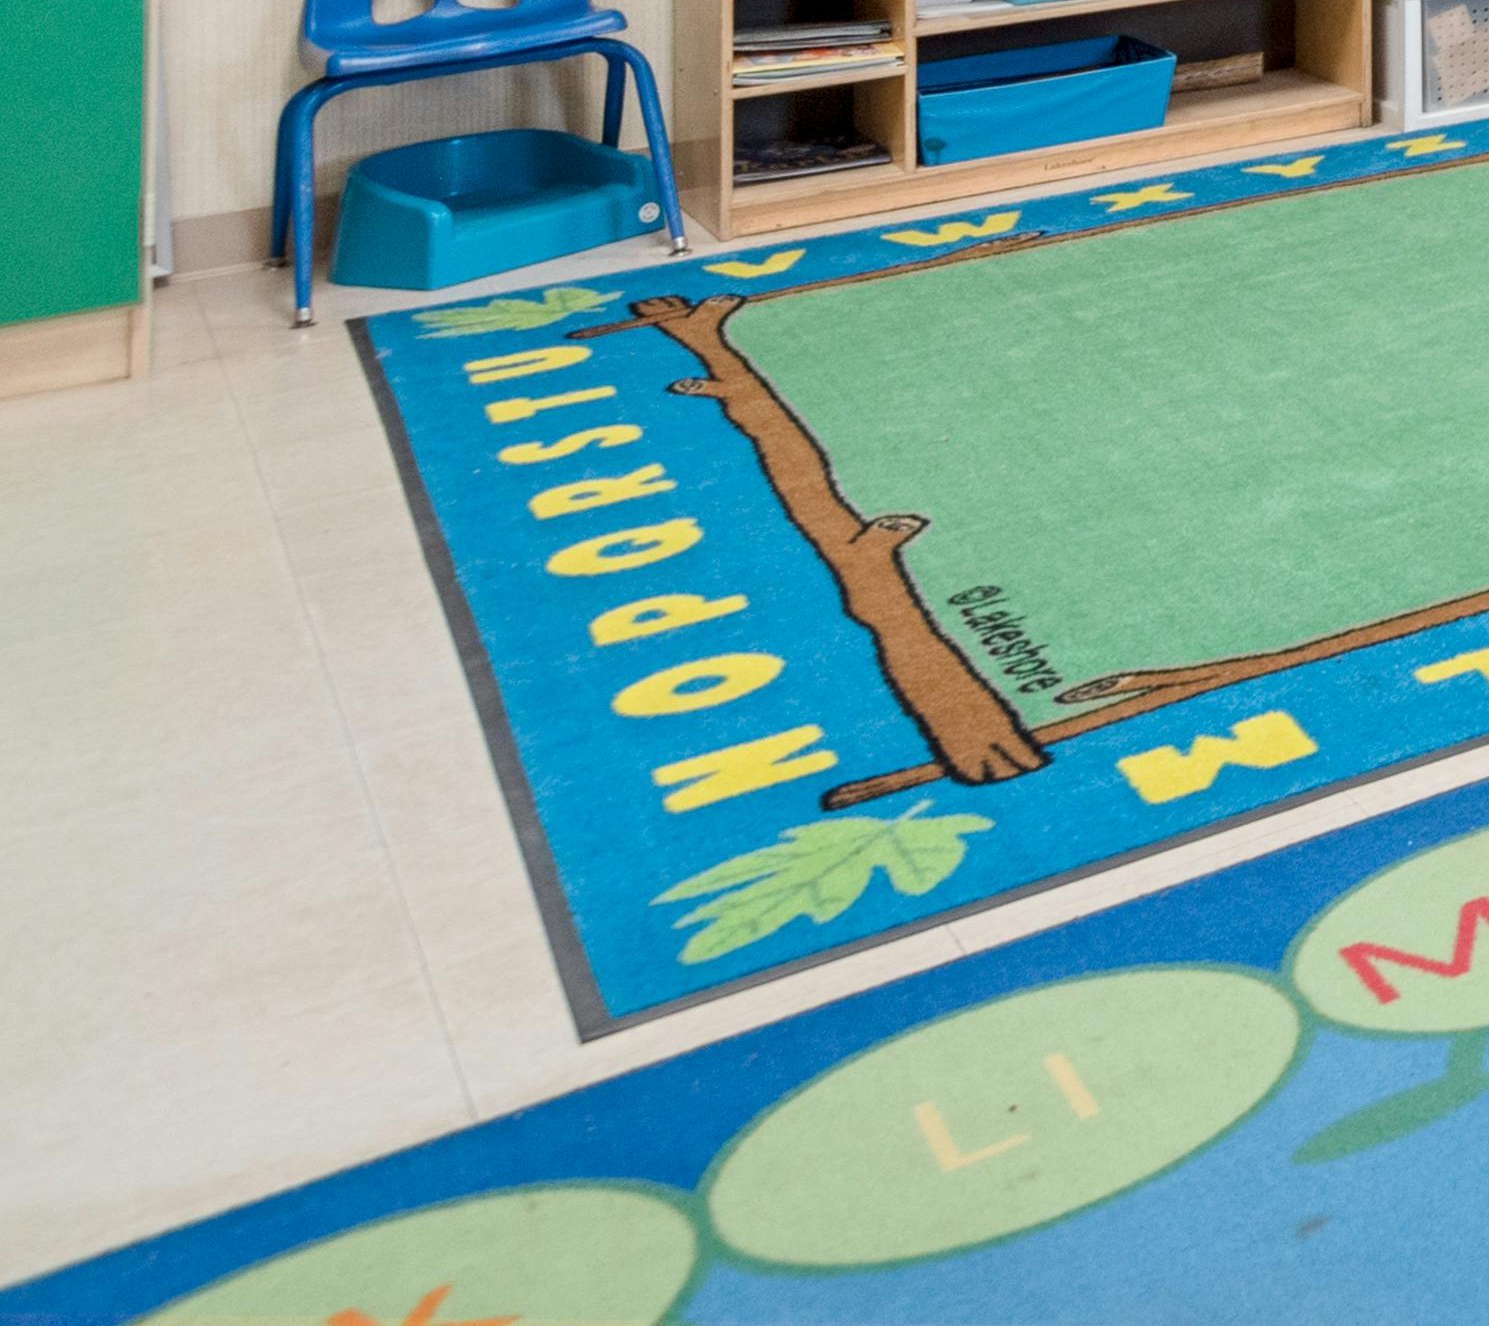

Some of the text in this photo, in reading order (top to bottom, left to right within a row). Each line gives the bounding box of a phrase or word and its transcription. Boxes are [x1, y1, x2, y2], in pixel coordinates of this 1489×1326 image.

[702, 247, 807, 280] V
[880, 210, 1022, 247] W
[1088, 182, 1196, 213] X
[1242, 154, 1325, 179] Y
[462, 345, 840, 814] N O P Q R S T U
